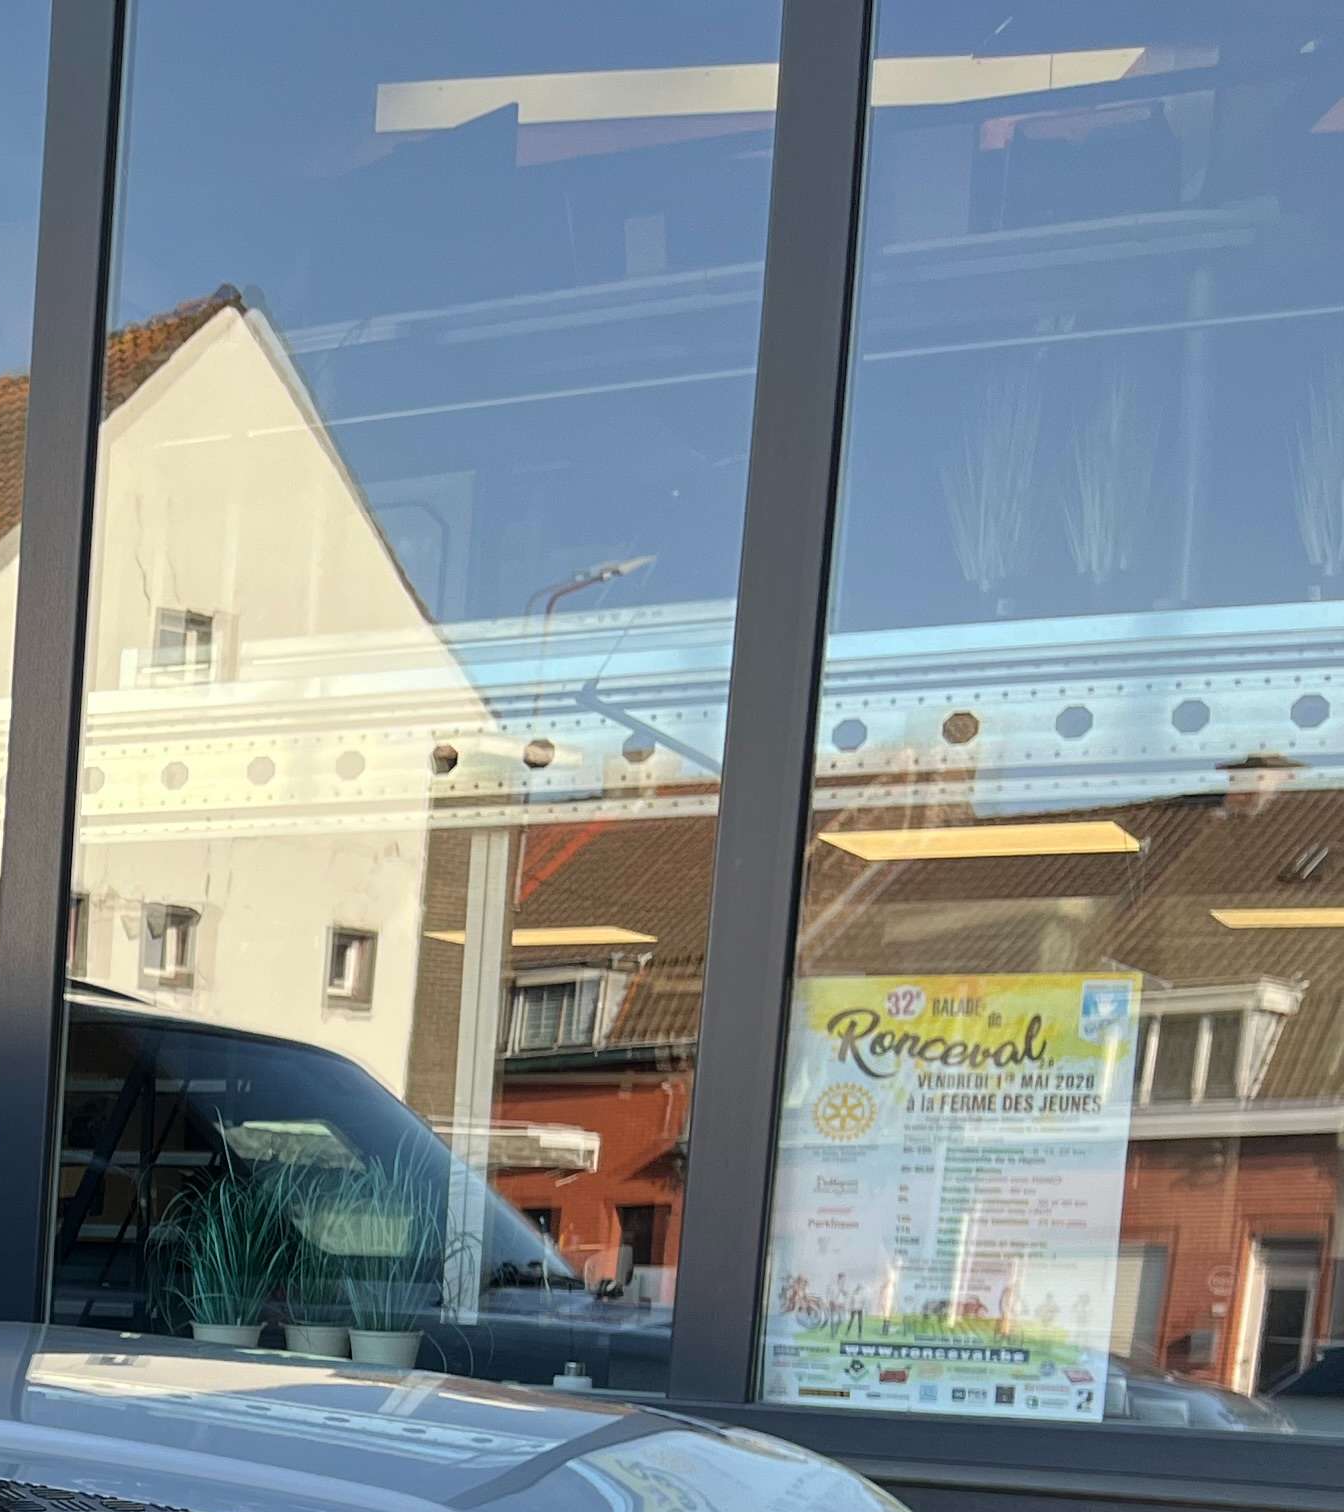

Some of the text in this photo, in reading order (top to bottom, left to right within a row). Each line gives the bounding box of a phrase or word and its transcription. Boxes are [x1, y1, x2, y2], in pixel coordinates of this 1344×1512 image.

[826, 1009, 1047, 1079] Ronceval
[917, 1073, 988, 1090] VENDREDI
[1020, 1074, 1049, 1090] MAI
[920, 1093, 934, 1113] la
[940, 1093, 997, 1114] FERME
[1002, 1094, 1034, 1113] DES
[1039, 1094, 1102, 1114] JEUNES
